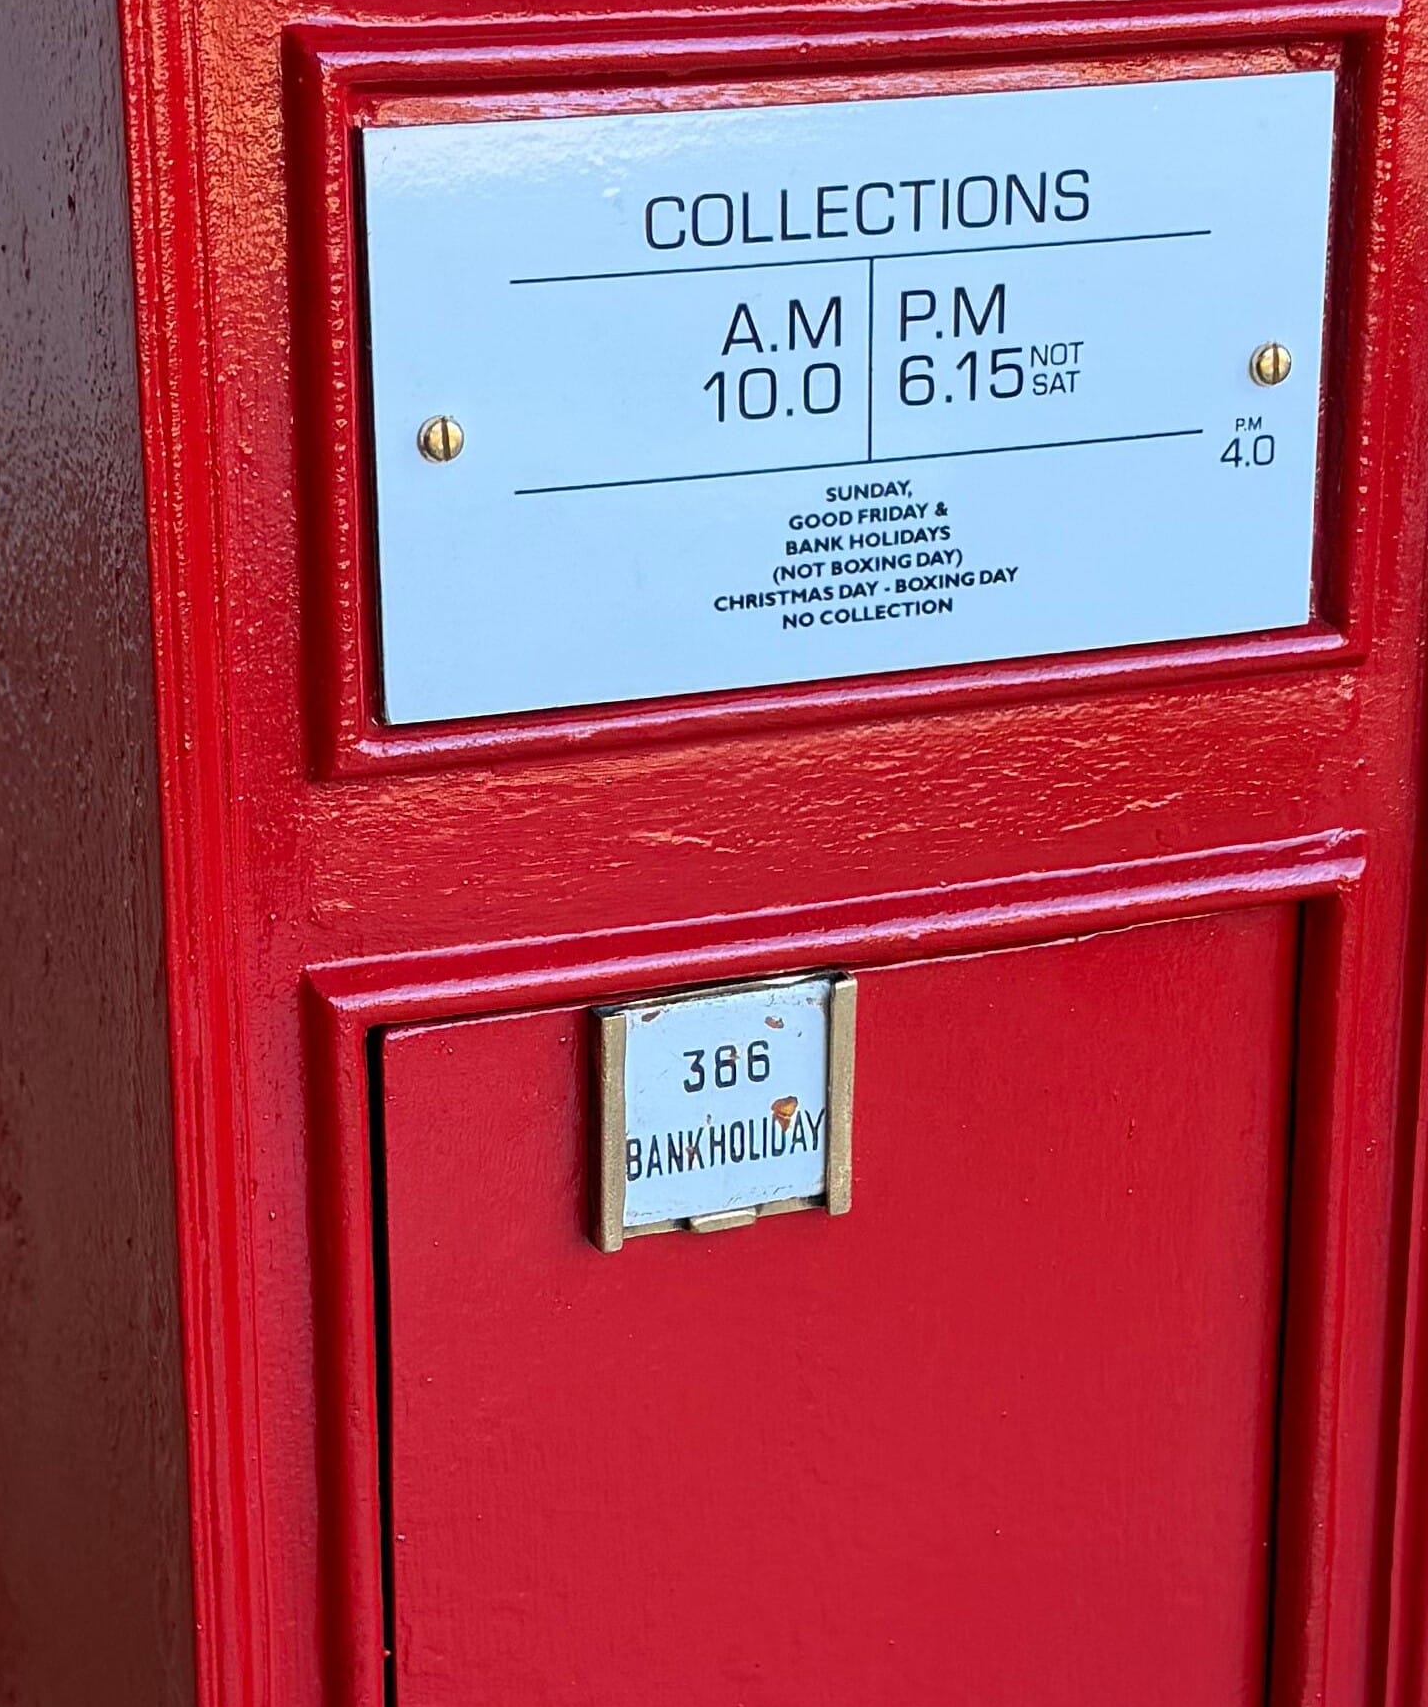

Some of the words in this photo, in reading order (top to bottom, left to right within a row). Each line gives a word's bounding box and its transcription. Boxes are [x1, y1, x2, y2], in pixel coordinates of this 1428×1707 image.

[646, 169, 1089, 249] COLLECTIONS
[722, 296, 841, 356] A.M
[901, 284, 1005, 341] P.M
[1031, 341, 1084, 367] NOT
[900, 346, 1023, 406] 6.15
[1033, 370, 1080, 395] SAT
[704, 363, 841, 422] 10.0
[1235, 416, 1263, 432] P.M
[1220, 435, 1274, 467] 4.0
[826, 479, 913, 503] SUNDAY,
[789, 510, 853, 530] GOOD
[858, 503, 928, 524] FRIDAY
[934, 501, 949, 517] &
[786, 535, 844, 556] BANK
[849, 525, 951, 550] HOLIDAYS
[772, 562, 825, 586] (NOT
[831, 553, 912, 576] BOXING
[916, 548, 963, 568] DAY)
[714, 586, 834, 612] CHRISTMAS
[839, 580, 879, 599] DAY
[895, 571, 974, 594] BOXING
[979, 567, 1018, 585] DAY
[782, 612, 814, 630] NO
[819, 598, 953, 625] COLLECTION
